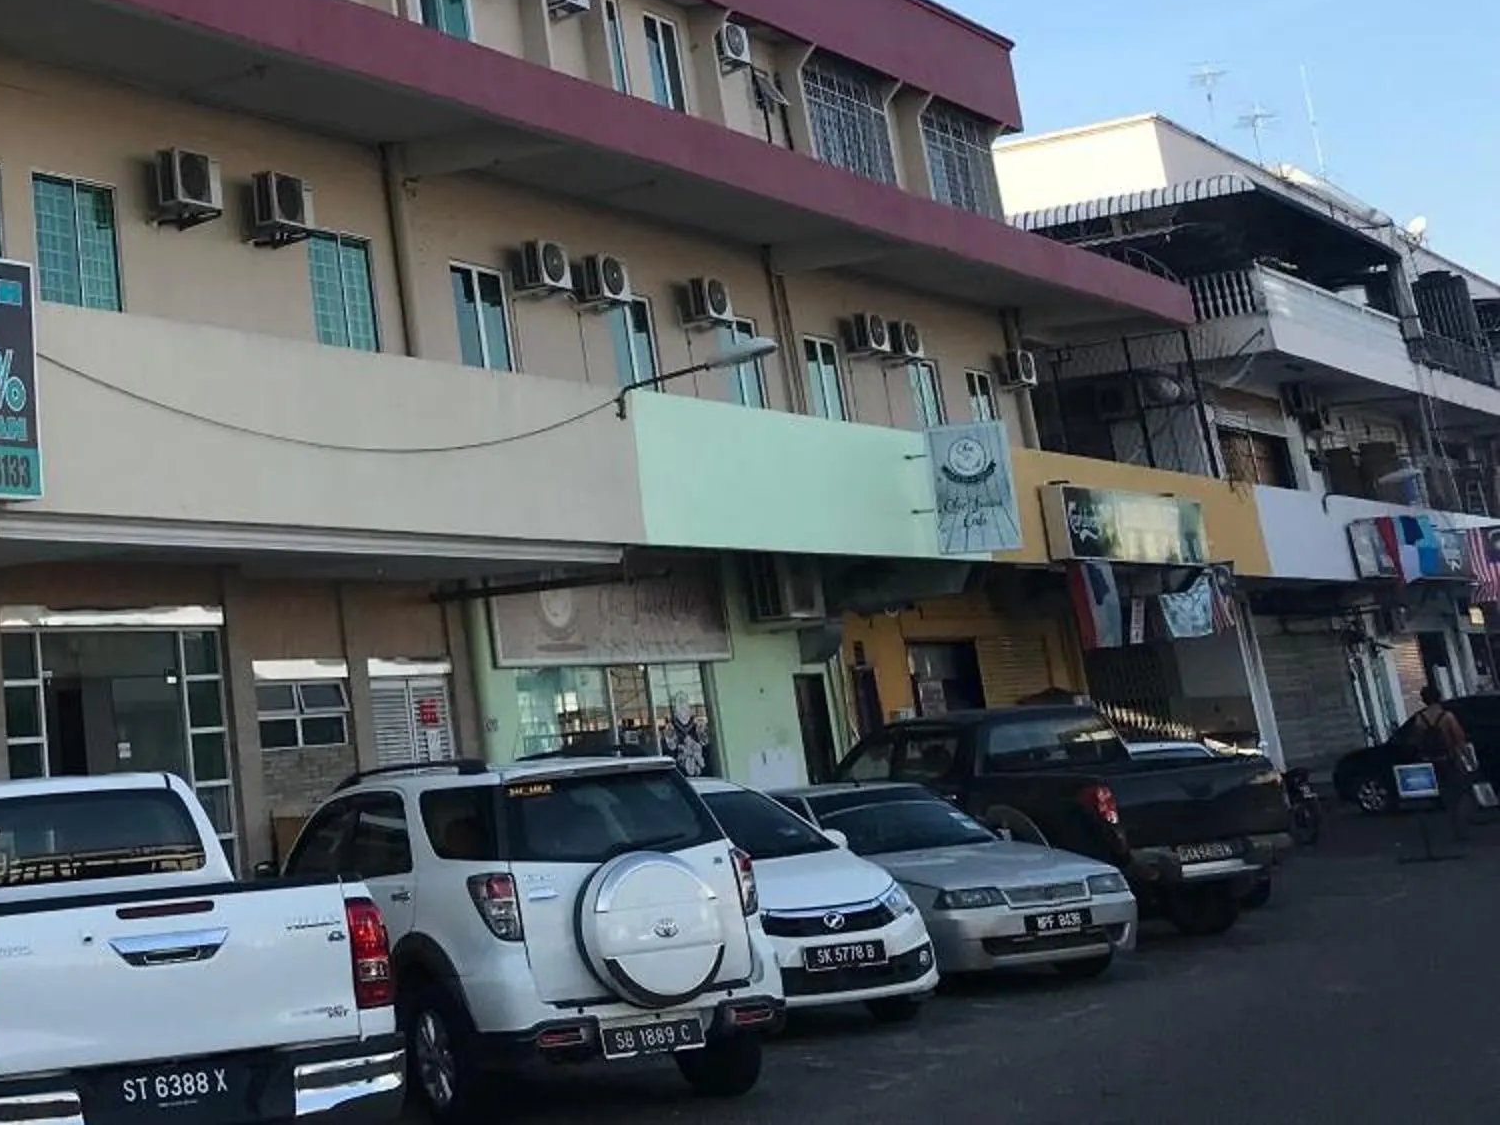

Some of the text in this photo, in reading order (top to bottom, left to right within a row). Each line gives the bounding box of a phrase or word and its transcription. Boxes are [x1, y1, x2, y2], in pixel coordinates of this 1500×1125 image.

[816, 947, 833, 964] SK
[615, 1024, 691, 1050] SB 1889 C
[123, 1068, 228, 1102] ST 6388 X
